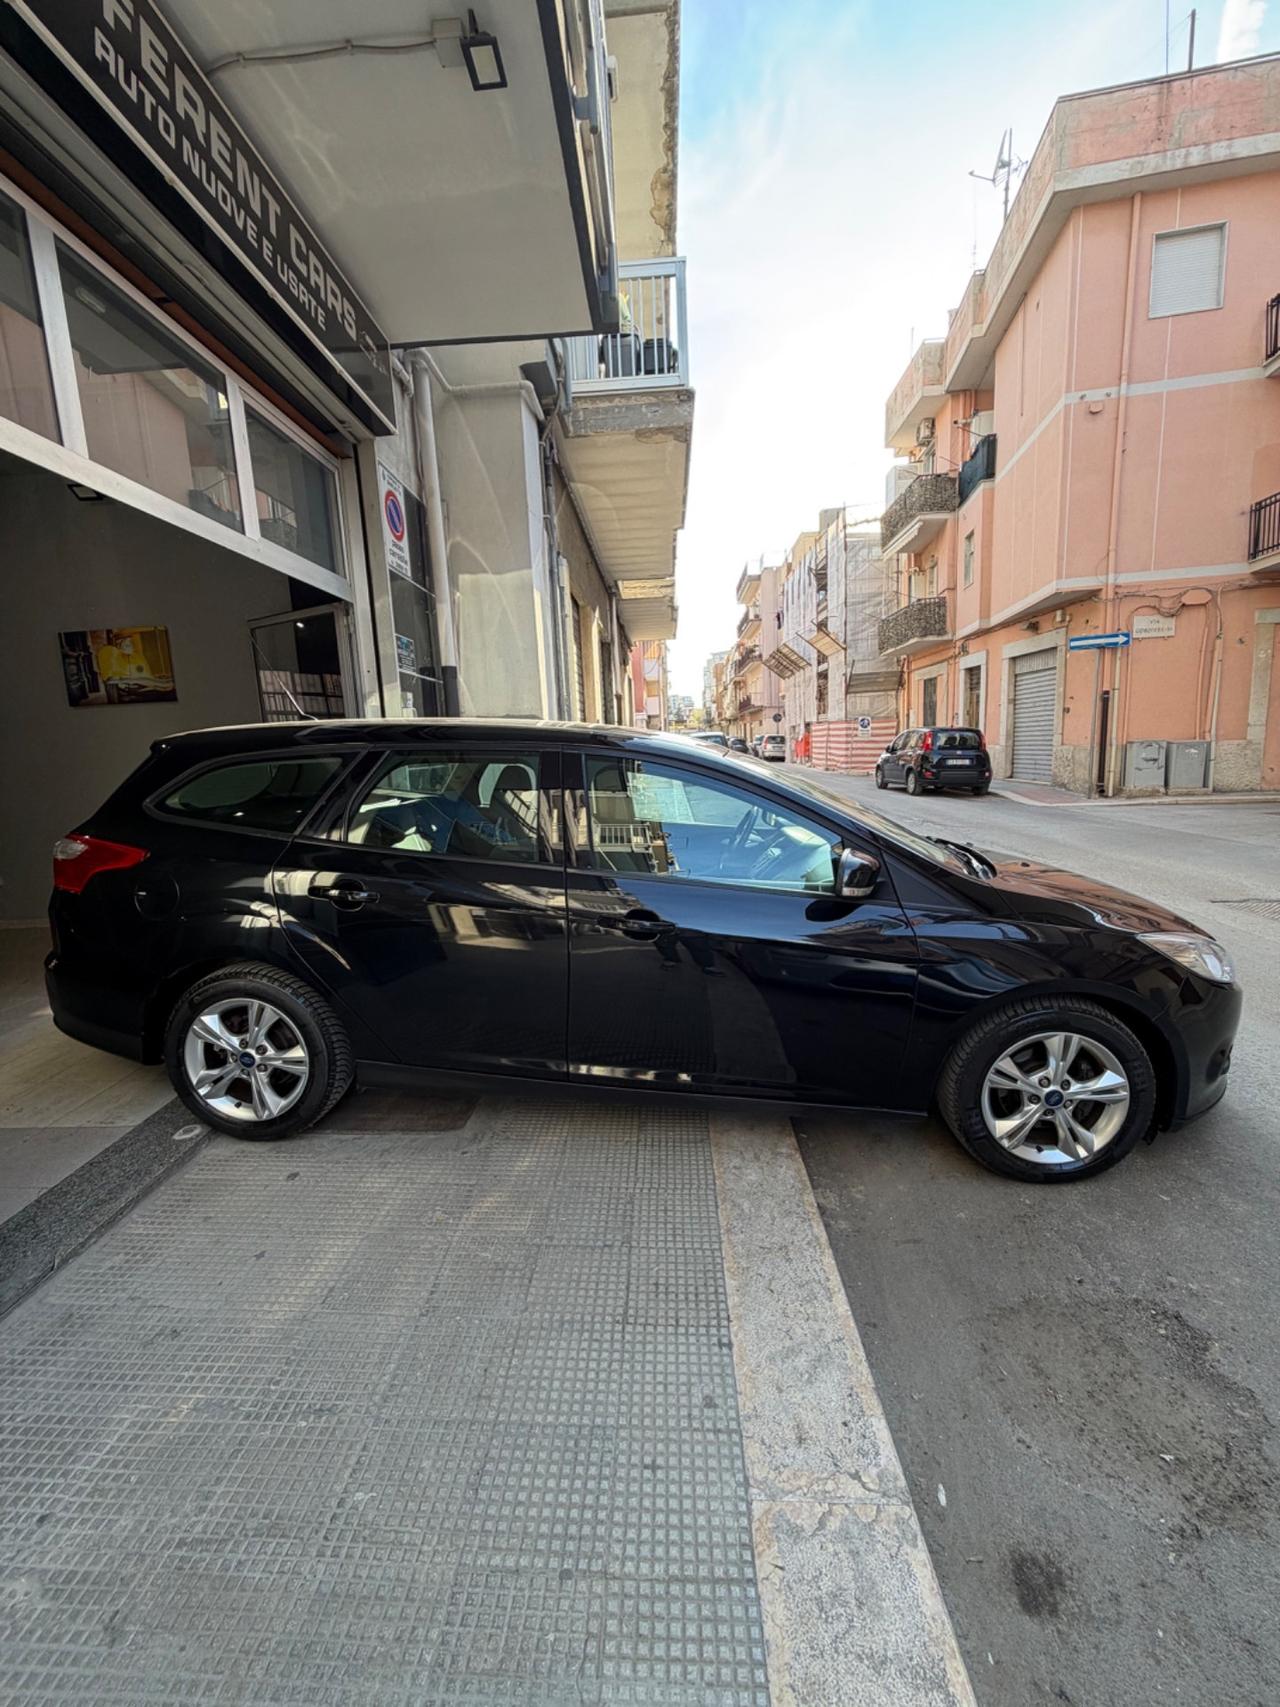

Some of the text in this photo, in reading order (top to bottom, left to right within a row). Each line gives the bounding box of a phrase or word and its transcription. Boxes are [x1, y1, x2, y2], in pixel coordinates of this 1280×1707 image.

[94, 26, 326, 332] AUTO NUOVE E USATE
[289, 223, 357, 342] CARS
